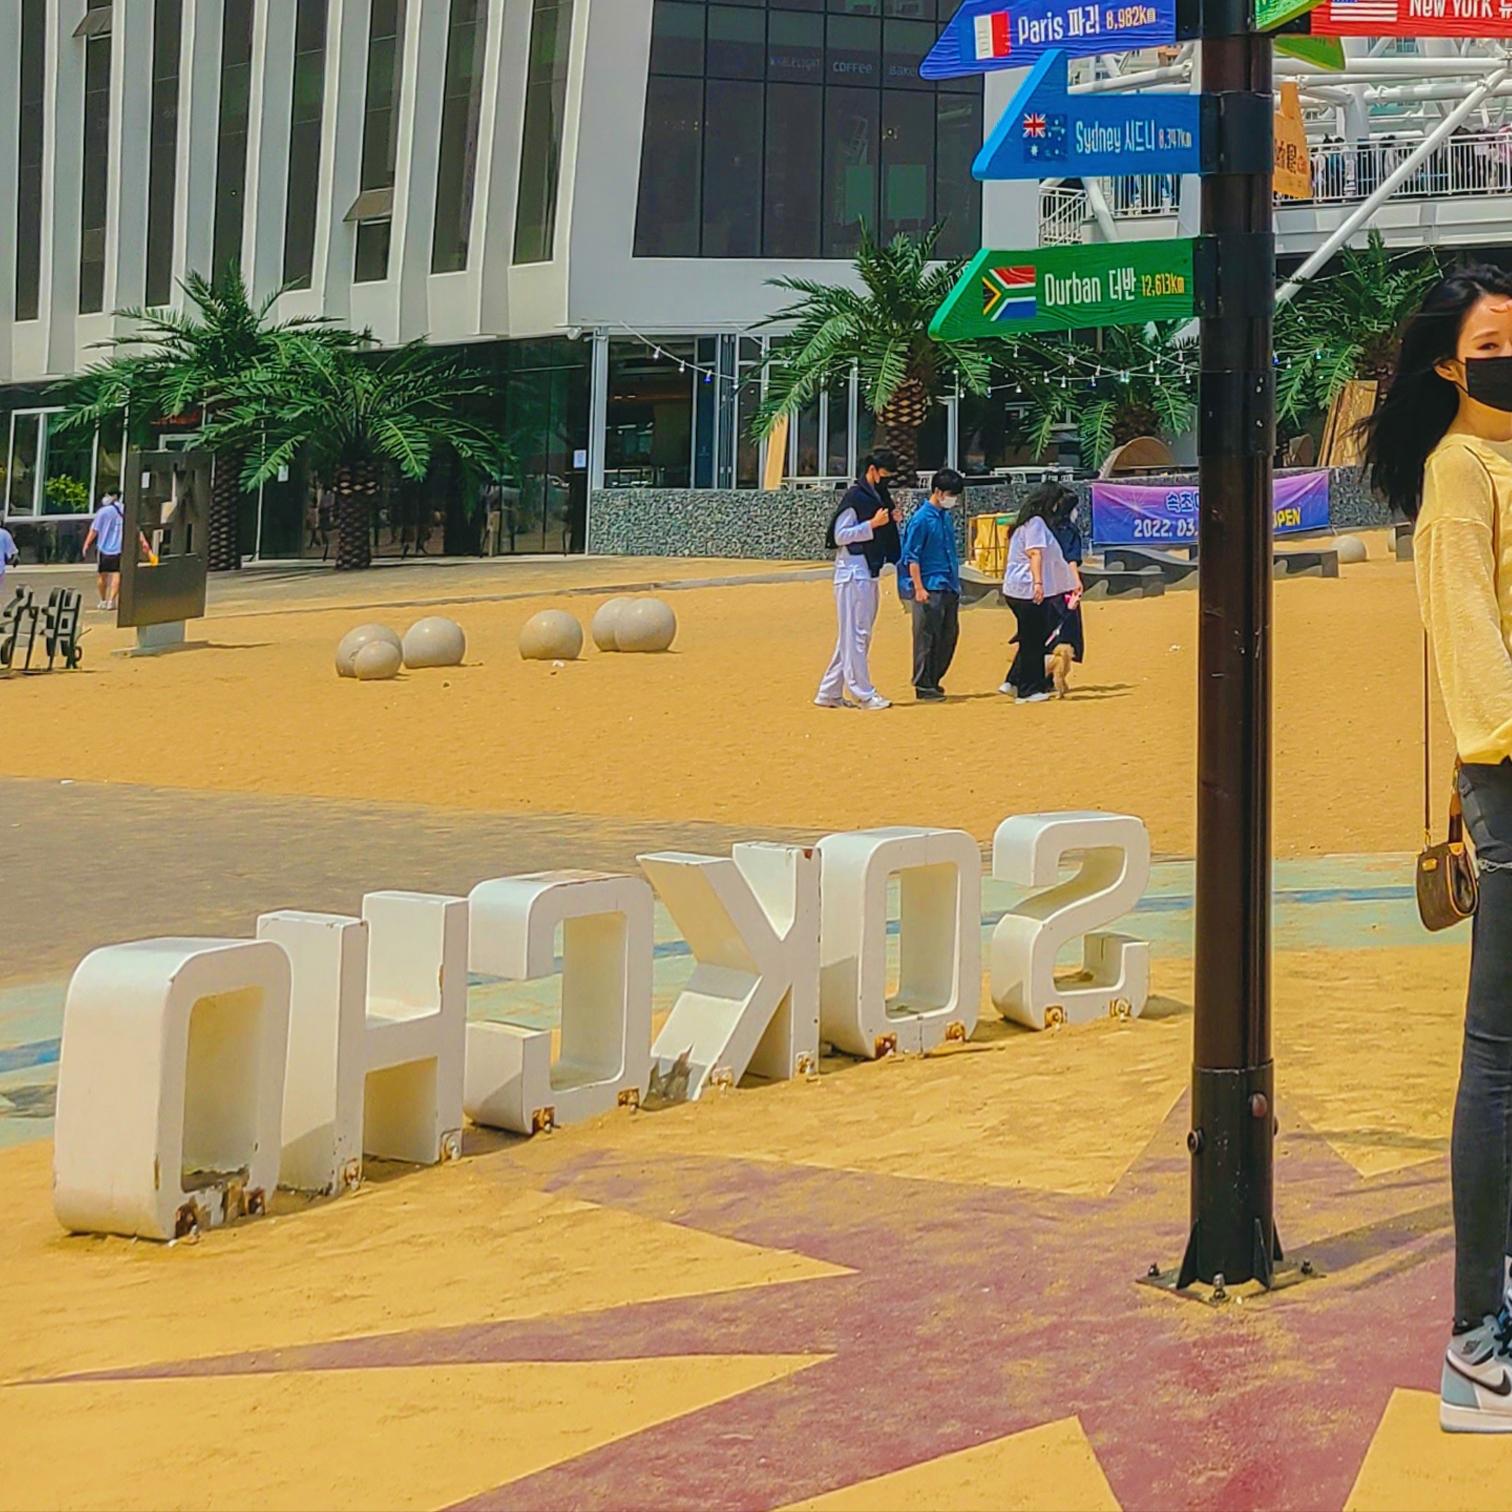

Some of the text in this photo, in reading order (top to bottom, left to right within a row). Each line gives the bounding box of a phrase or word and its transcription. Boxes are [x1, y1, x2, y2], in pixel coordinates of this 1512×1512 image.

[1018, 12, 1064, 46] Paris
[1067, 4, 1100, 36] 파리
[1076, 120, 1121, 154] Sydney
[1124, 119, 1155, 152] 시드니
[1045, 271, 1101, 306] Durban
[1109, 267, 1137, 300] 더반
[1134, 519, 1173, 537] 2022.
